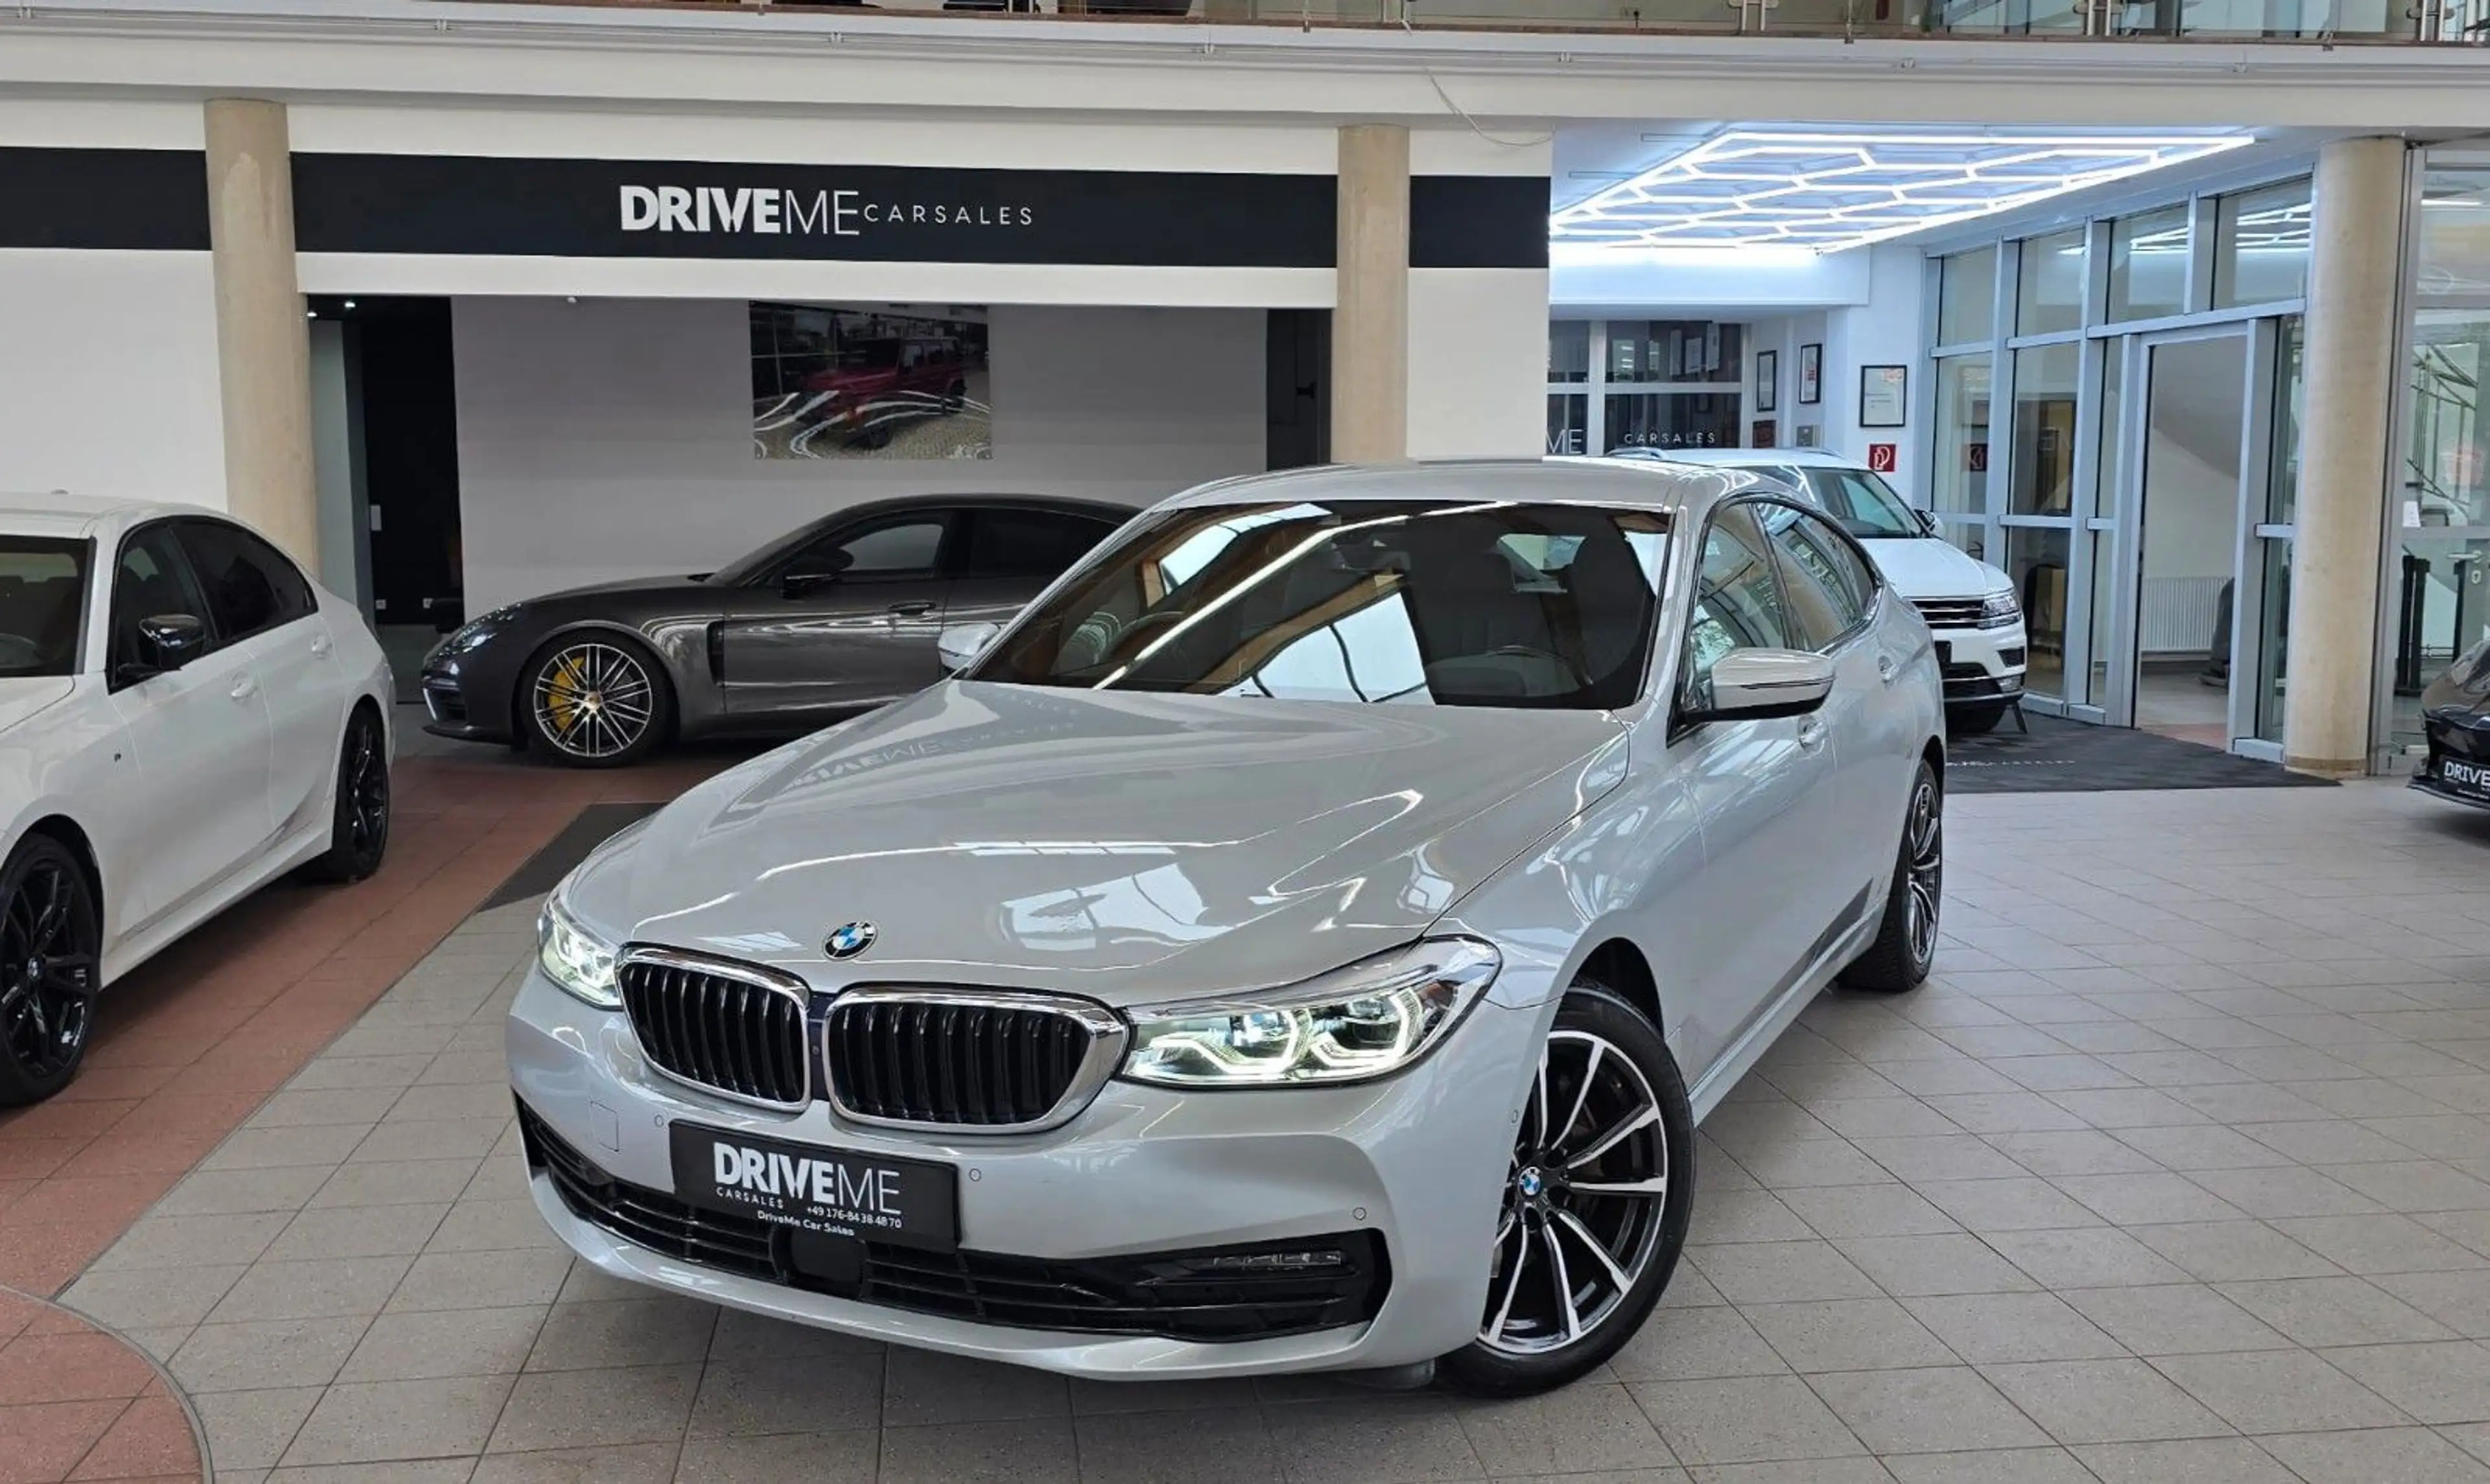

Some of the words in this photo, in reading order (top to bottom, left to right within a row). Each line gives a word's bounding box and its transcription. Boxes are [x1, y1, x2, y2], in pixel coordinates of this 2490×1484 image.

[864, 204, 1032, 225] CARSALES
[1624, 432, 1715, 445] CARSALES
[716, 1186, 783, 1209] CARSALES
[802, 1218, 822, 1231] Car
